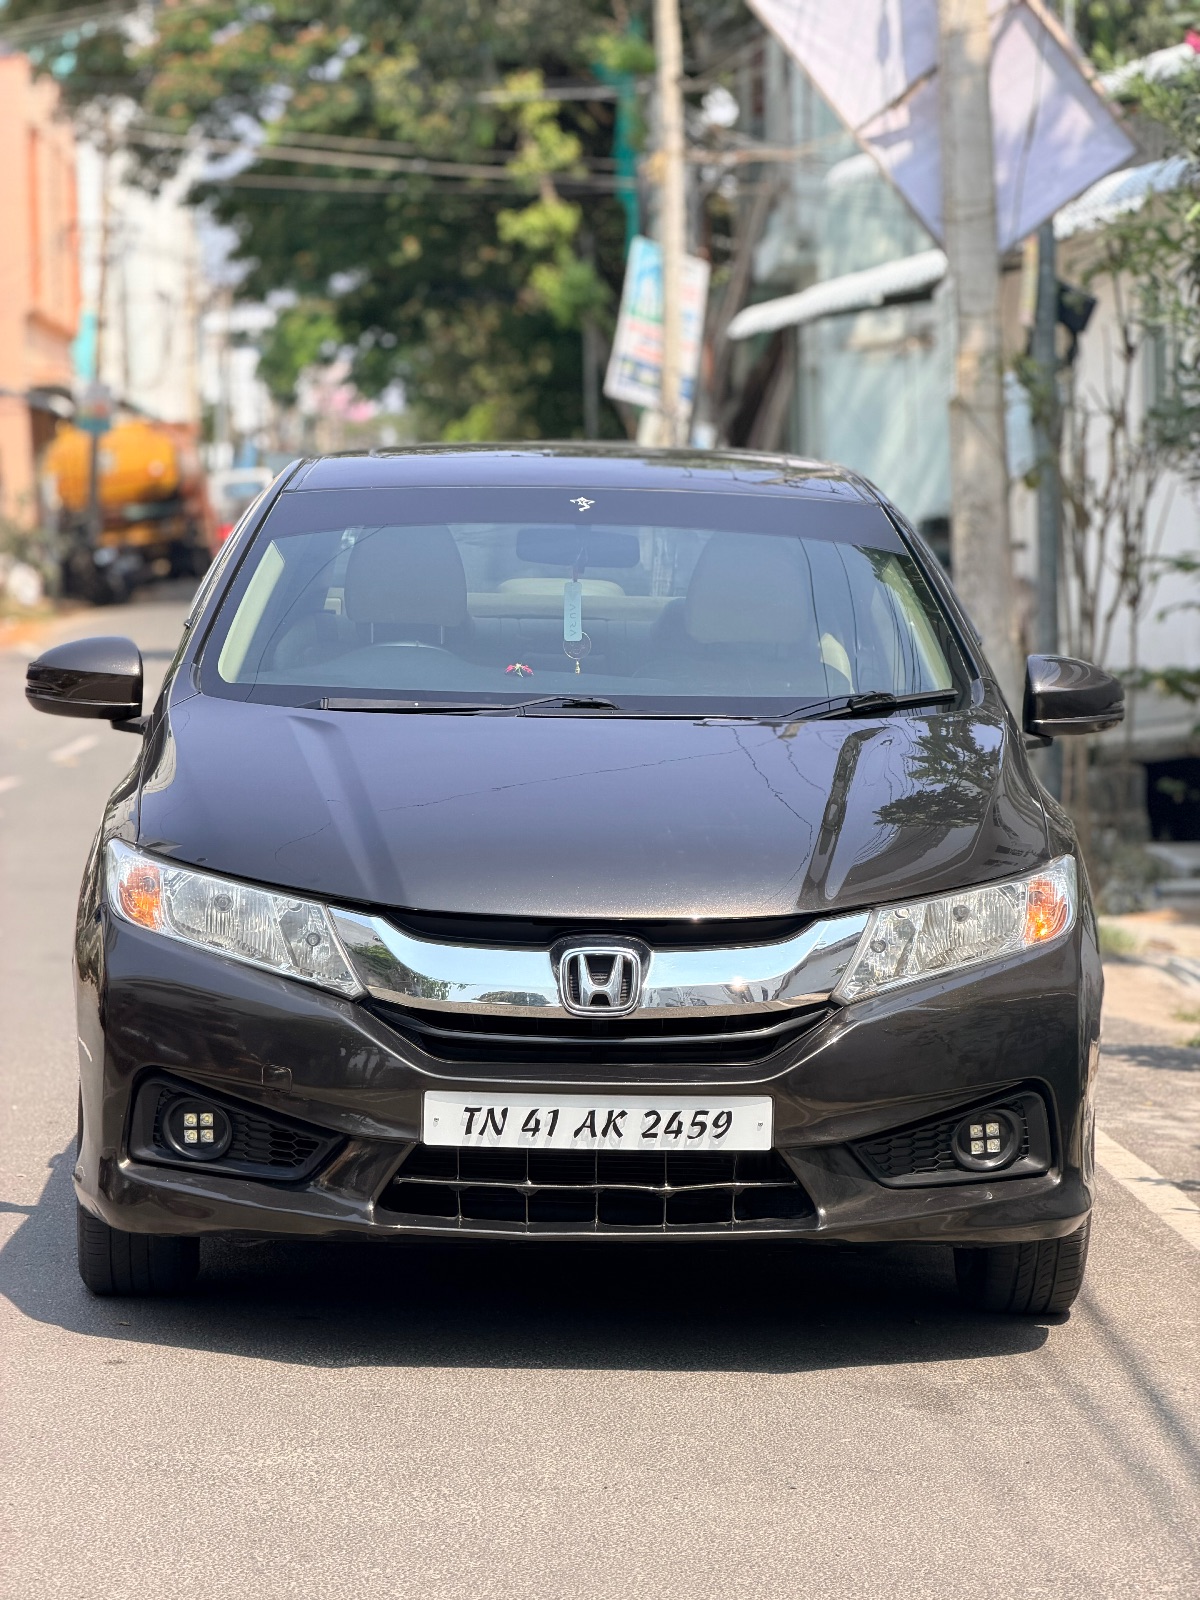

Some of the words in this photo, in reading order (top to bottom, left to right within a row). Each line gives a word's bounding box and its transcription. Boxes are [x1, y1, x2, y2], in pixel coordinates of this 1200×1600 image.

[463, 1106, 509, 1136] TN
[521, 1108, 560, 1138] 41
[573, 1109, 629, 1139] AK
[641, 1110, 733, 1140] 2459
